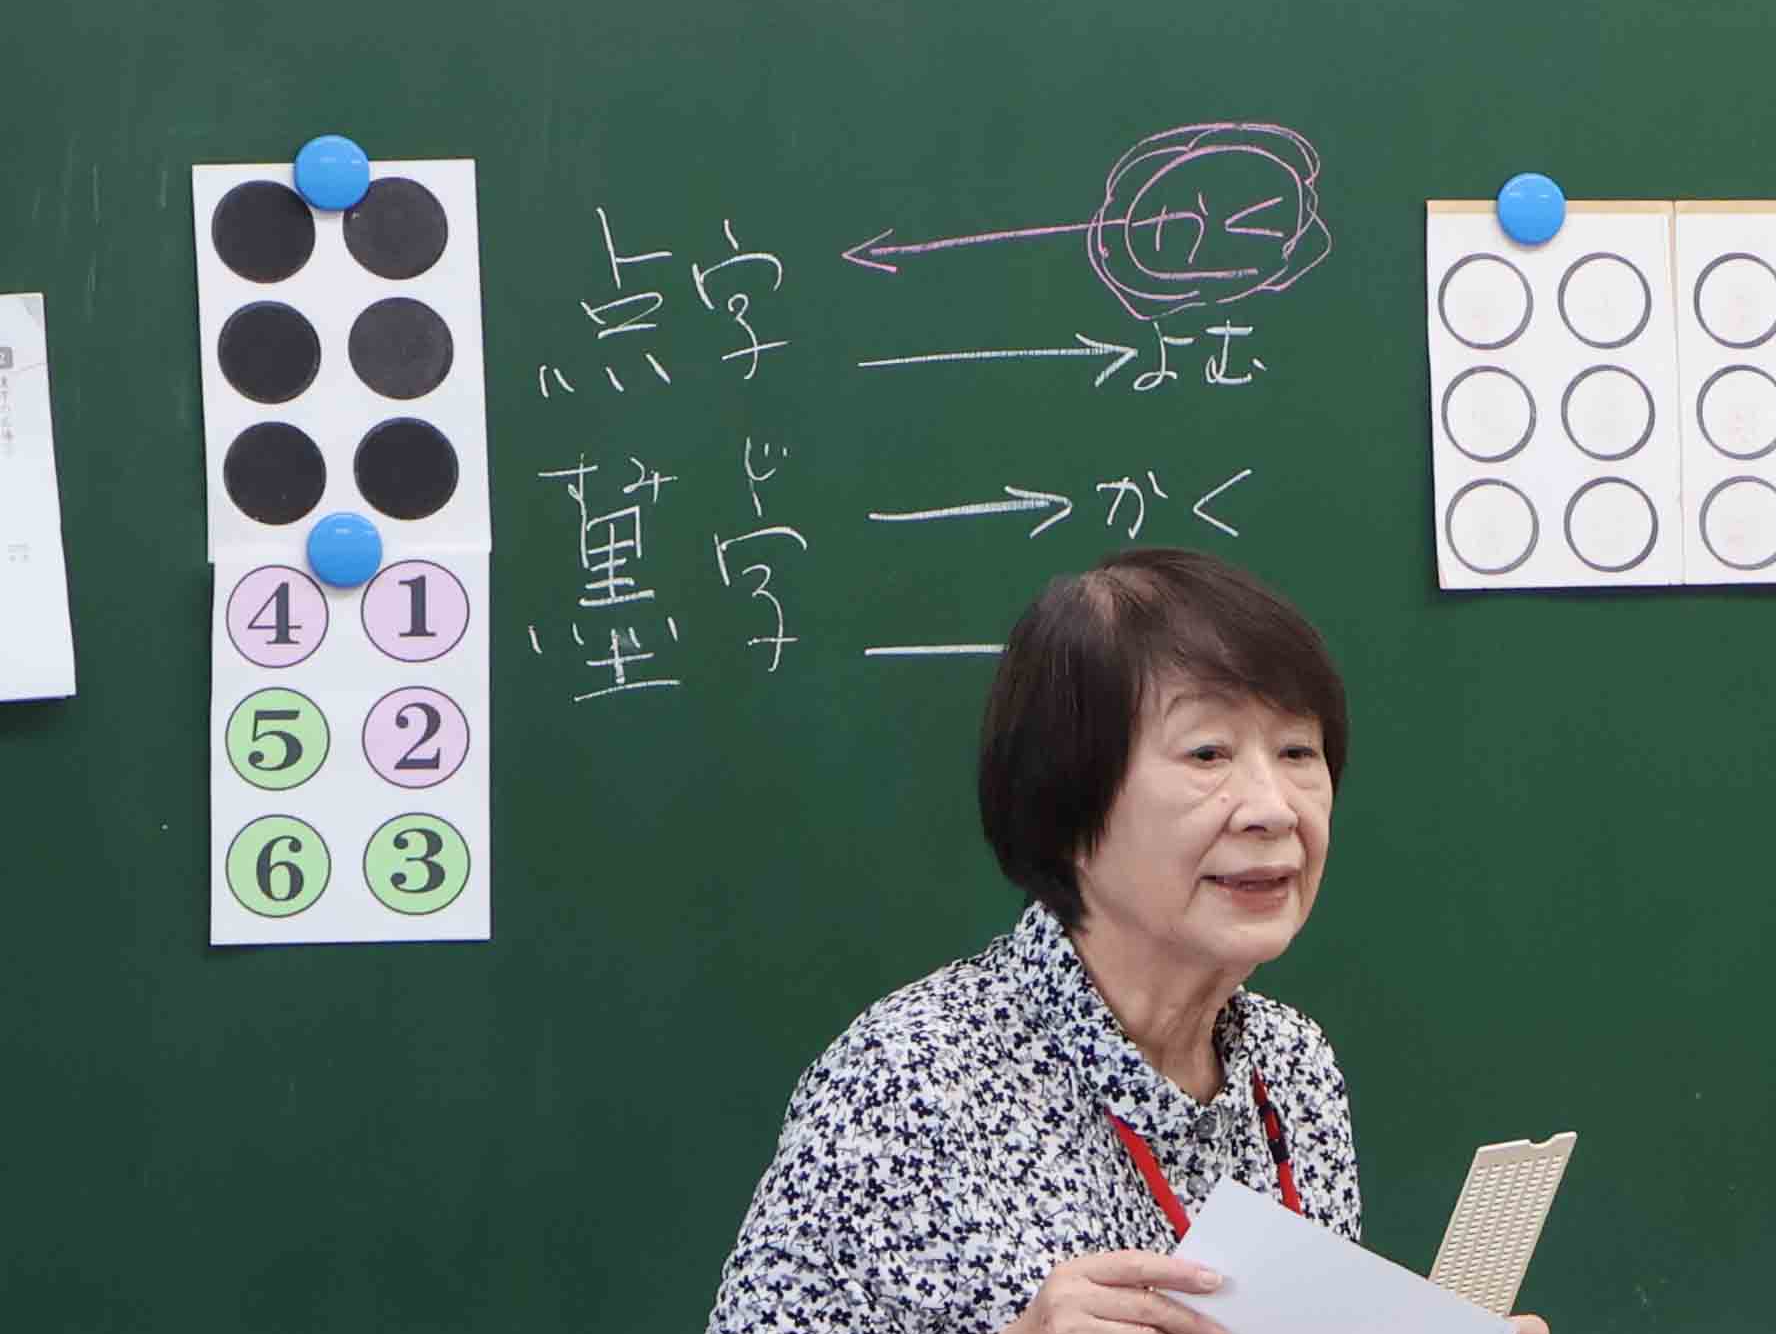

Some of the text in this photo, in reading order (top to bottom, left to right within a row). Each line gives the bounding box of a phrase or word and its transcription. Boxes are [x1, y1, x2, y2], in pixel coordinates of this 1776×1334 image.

[1132, 192, 1285, 264] かく
[538, 207, 789, 397] 点字
[1133, 320, 1267, 392] よむ
[1096, 470, 1253, 539] かく
[247, 581, 303, 645] 4
[399, 575, 437, 638] 1
[247, 709, 305, 773] 5
[393, 703, 444, 771] 2
[256, 835, 305, 901] 6
[391, 829, 446, 894] 3
